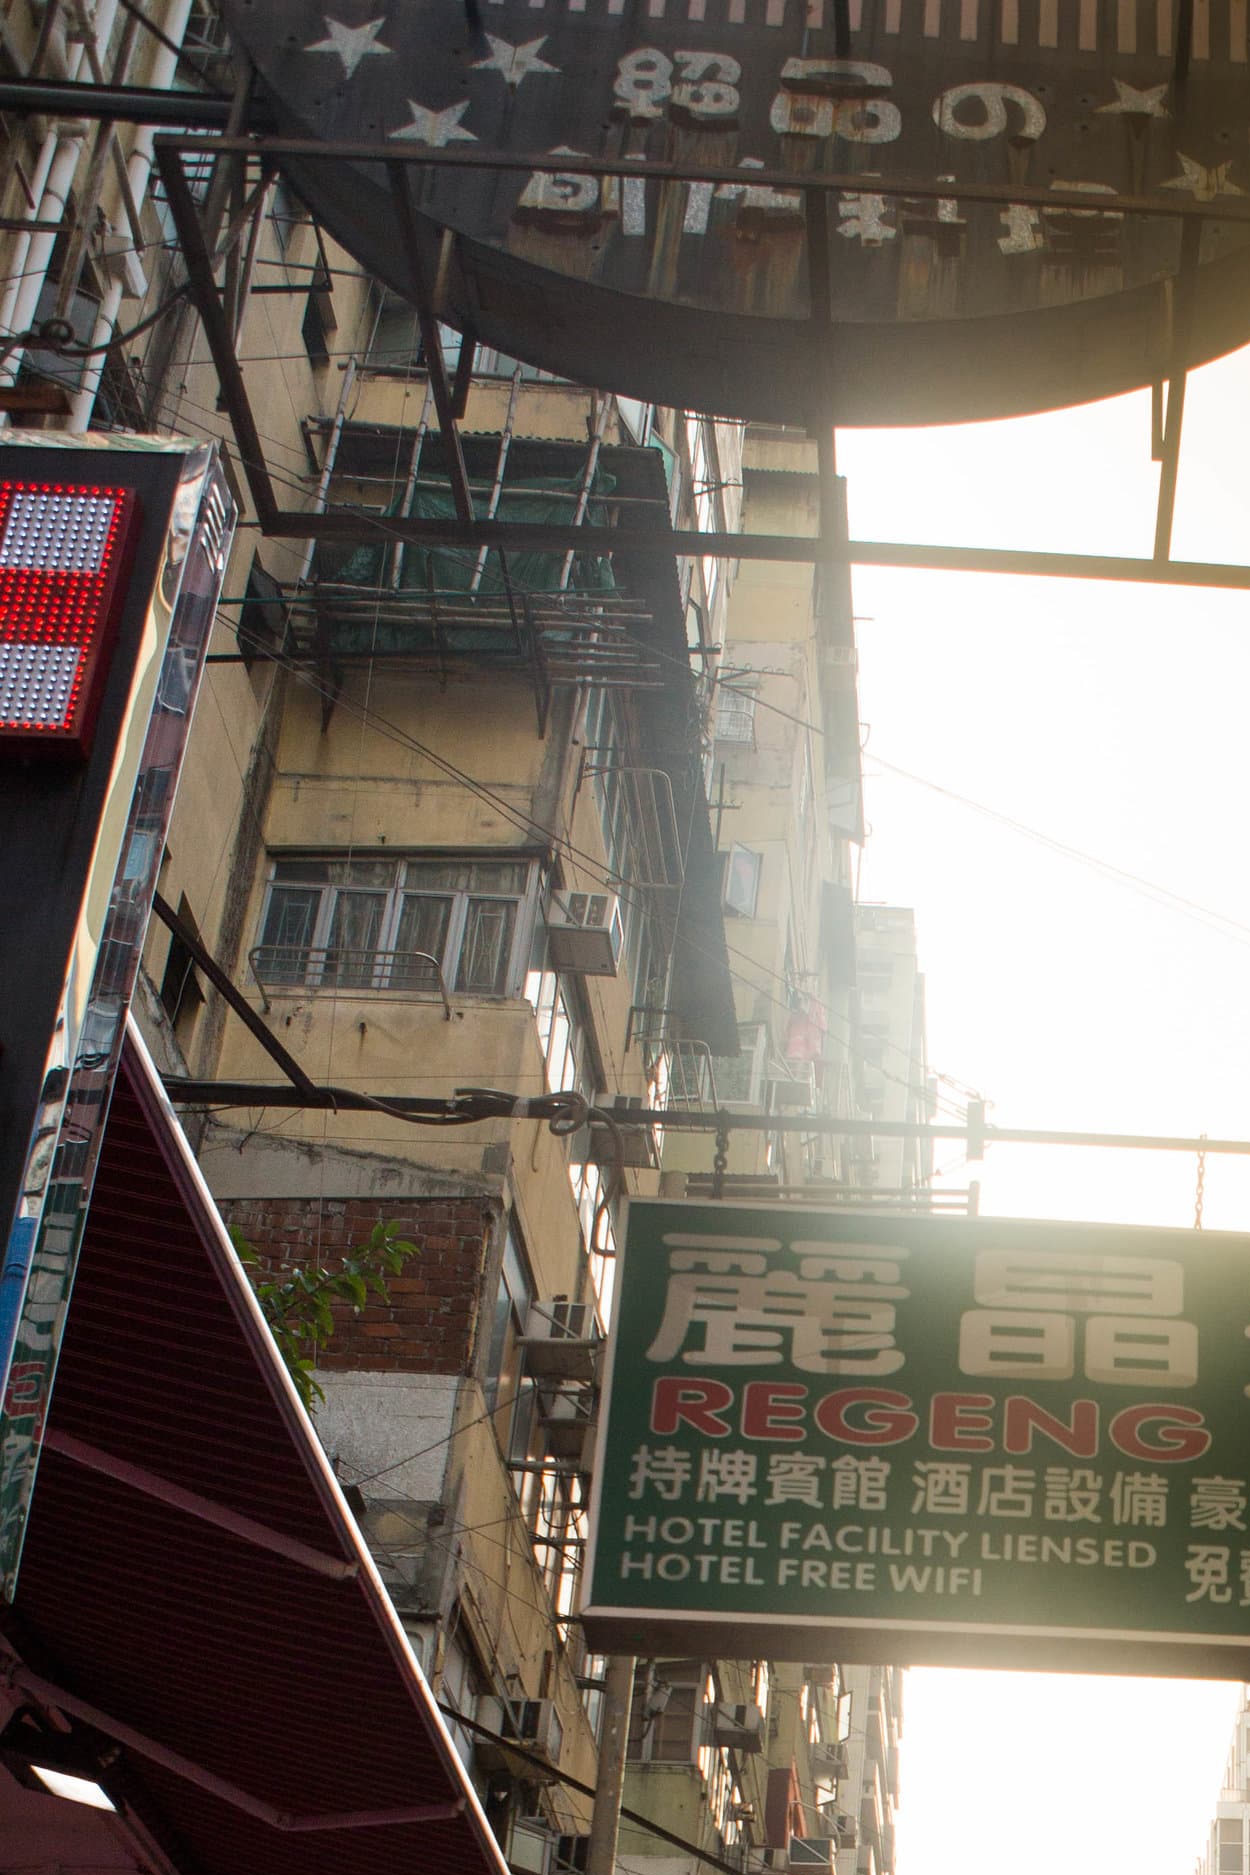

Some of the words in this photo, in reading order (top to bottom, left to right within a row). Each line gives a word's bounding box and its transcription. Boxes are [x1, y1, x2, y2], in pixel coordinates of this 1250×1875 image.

[649, 1375, 1212, 1464] REGENG
[628, 1445, 892, 1511] 持牌賓館
[910, 1459, 1169, 1528] 酒店設備
[619, 1551, 765, 1586] HOTEL
[777, 1558, 876, 1592] FREE
[889, 1564, 983, 1597] WIFI
[623, 1515, 766, 1550] HOTEL
[779, 1522, 969, 1559] FACILITY
[980, 1532, 1158, 1569] LIENSED
